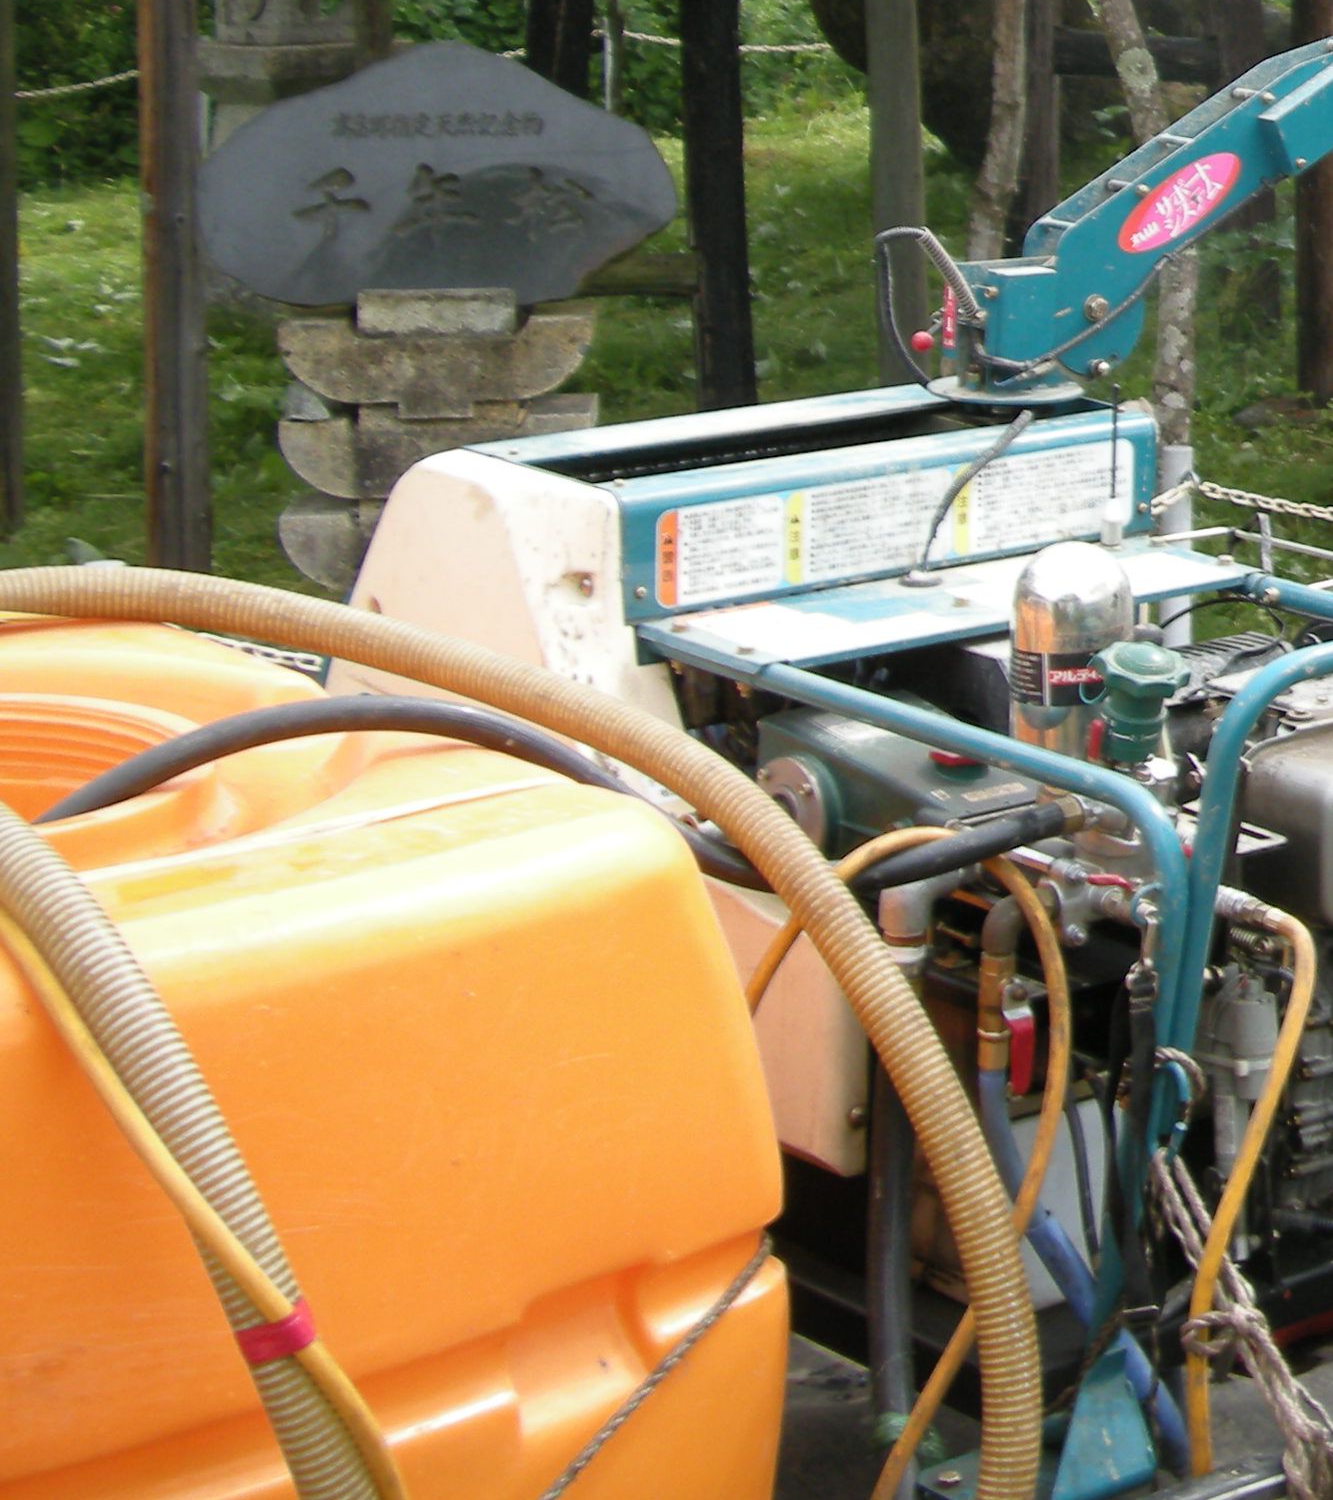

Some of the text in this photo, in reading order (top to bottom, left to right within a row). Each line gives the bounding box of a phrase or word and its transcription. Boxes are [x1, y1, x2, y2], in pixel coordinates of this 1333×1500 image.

[292, 163, 597, 241] 千年松
[1156, 162, 1212, 217] サポート
